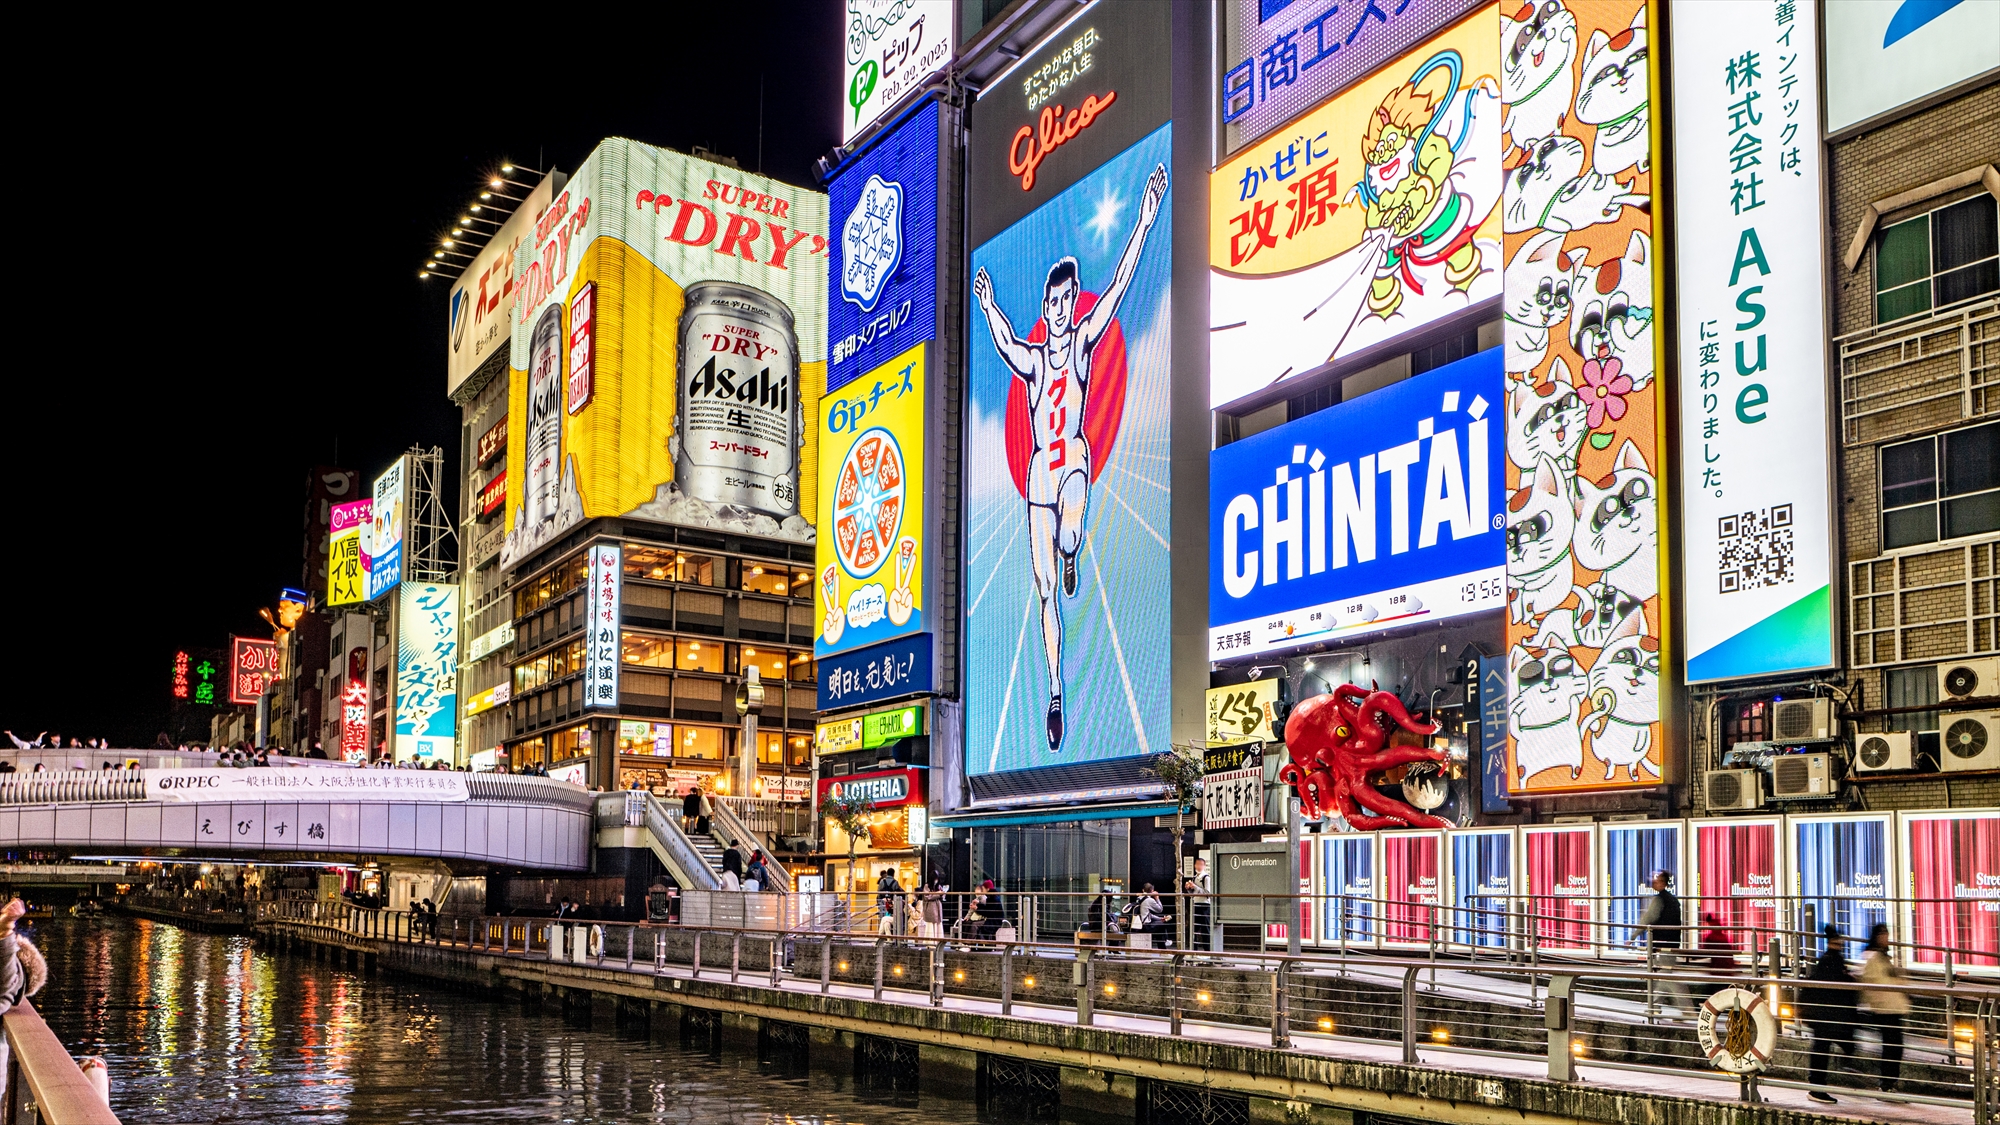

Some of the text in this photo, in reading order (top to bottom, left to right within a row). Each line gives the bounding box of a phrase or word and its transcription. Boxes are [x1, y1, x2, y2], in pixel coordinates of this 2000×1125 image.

[882, 13, 926, 79] ピップ
[1023, 27, 1101, 95] すこやかな毎日、
[882, 80, 902, 105] Feb.
[903, 65, 919, 87] 22,
[1028, 53, 1093, 111] ゆたかな人生
[1774, 0, 1802, 178] 善インテックは、
[1009, 90, 1117, 191] Glico
[1725, 50, 1766, 216] 株式会社
[1239, 131, 1328, 202] かぜに
[703, 178, 790, 220] SUPER
[1229, 158, 1339, 267] 改源
[535, 190, 570, 249] SUPER
[571, 292, 590, 336] ASAHI
[723, 324, 760, 340] SUPER
[832, 300, 912, 365] 雪印メグミルク
[1728, 226, 1772, 425] Asue
[570, 334, 590, 377] 1889
[569, 368, 588, 408] OSAKA
[689, 354, 788, 414] Asahi
[528, 374, 560, 438] Asahi
[727, 408, 752, 430] 生
[754, 408, 774, 417] PRECISION
[754, 420, 771, 429] MASTER
[1047, 369, 1069, 472] グリコ
[1699, 319, 1724, 499] に変わりました。
[710, 440, 769, 460] スーパードライ
[859, 440, 878, 457] SNOW
[725, 477, 751, 489] 生ビール
[1223, 391, 1490, 599] CHINTAI
[332, 538, 347, 602] バイト
[344, 537, 359, 600] 高収入
[601, 571, 614, 622] 本場の味
[1310, 611, 1322, 622] 6時
[1346, 603, 1363, 614] 12時
[1389, 594, 1407, 605] 18時
[1216, 630, 1252, 651] 天気予報
[1268, 620, 1284, 630] 24時
[174, 651, 189, 698] お好み焼
[196, 661, 216, 700] 千房
[1467, 659, 1478, 702] 2F
[1218, 690, 1264, 735] くくる
[231, 775, 314, 788] 一般社団法人
[319, 775, 457, 790] 大阪活性化事業実行委員会
[845, 778, 902, 801] LOTTERIA
[1206, 779, 1253, 819] 大阪に乾杯
[201, 818, 325, 840] えびす橋
[1242, 858, 1277, 866] information
[1420, 875, 1435, 886] Street
[1490, 875, 1508, 886] Street
[1568, 874, 1587, 886] Street
[1748, 872, 1771, 885] Street
[1855, 872, 1881, 885] Street
[1554, 884, 1588, 895] Illuminated
[1731, 883, 1773, 896] Illuminated
[1836, 882, 1883, 897] Illuminated
